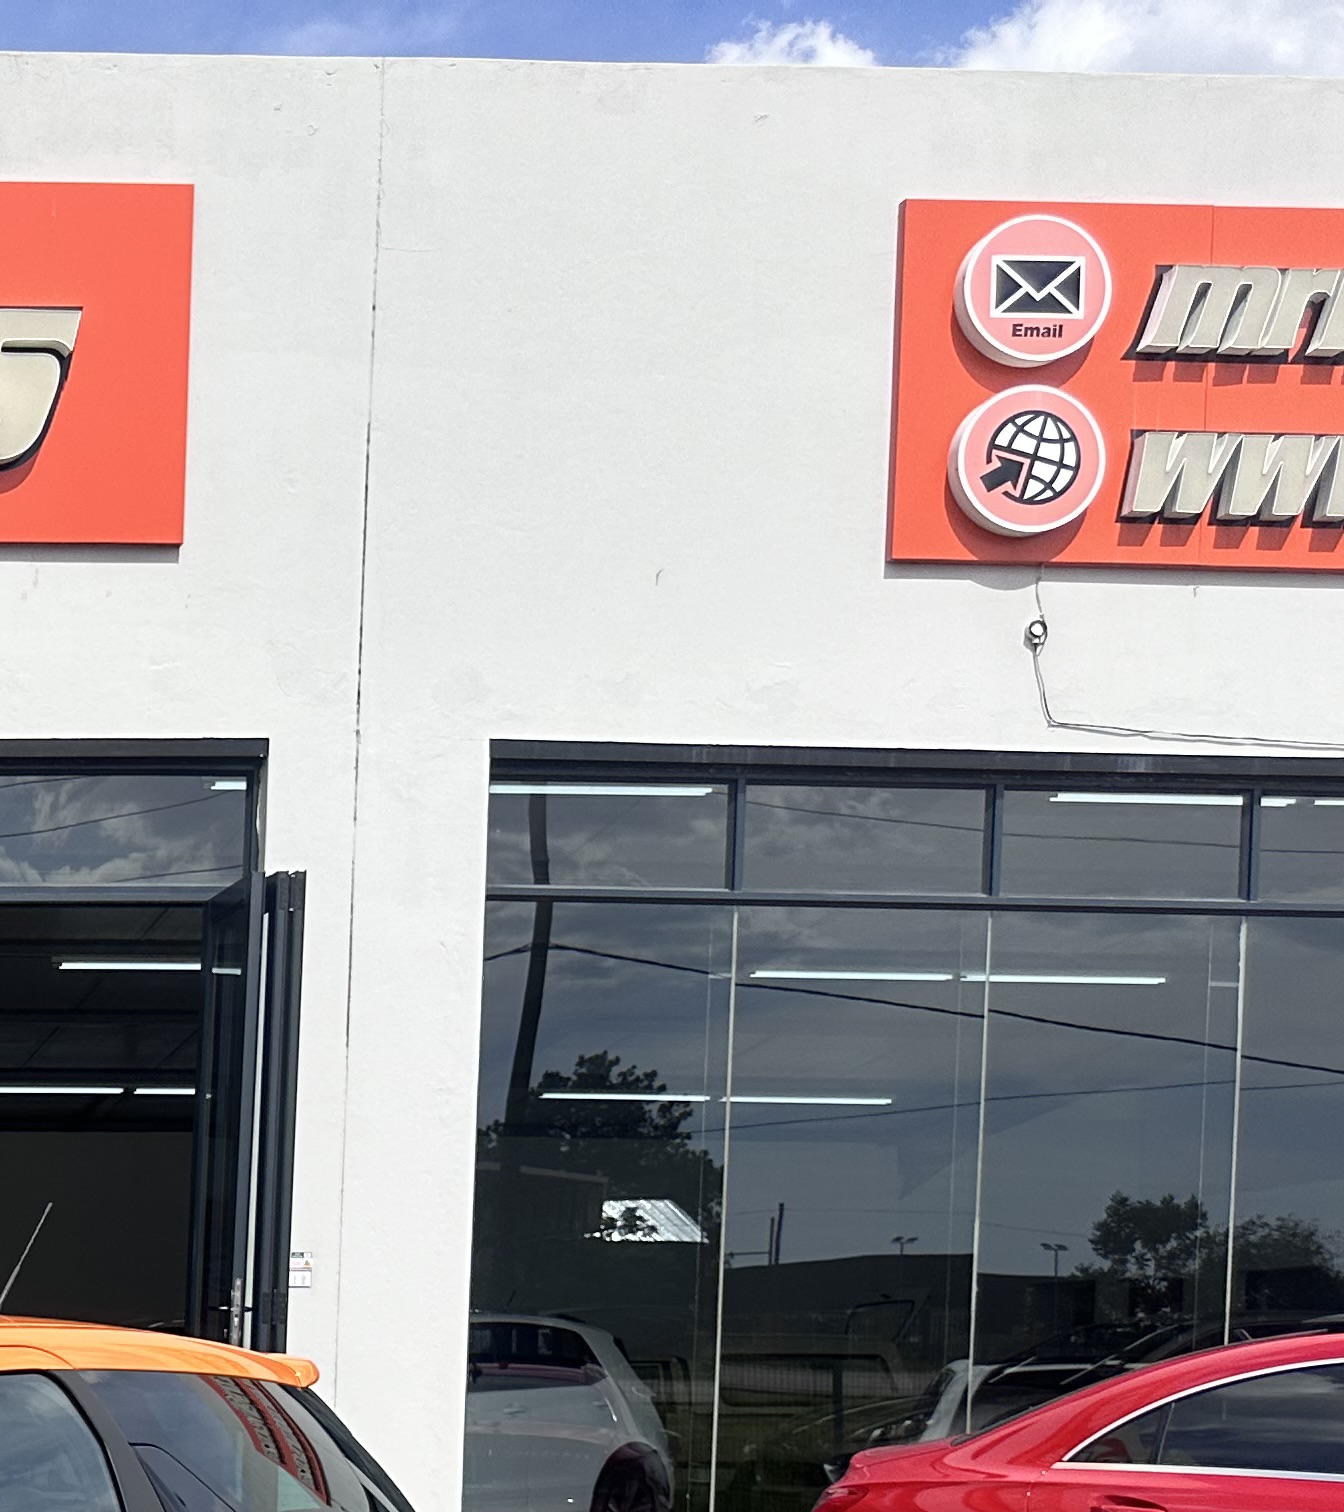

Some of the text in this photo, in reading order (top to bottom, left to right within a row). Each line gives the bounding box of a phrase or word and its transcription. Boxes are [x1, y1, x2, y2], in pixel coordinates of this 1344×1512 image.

[1011, 322, 1063, 339] Email
[1134, 264, 1343, 358] mr
[1119, 431, 1343, 522] ww
